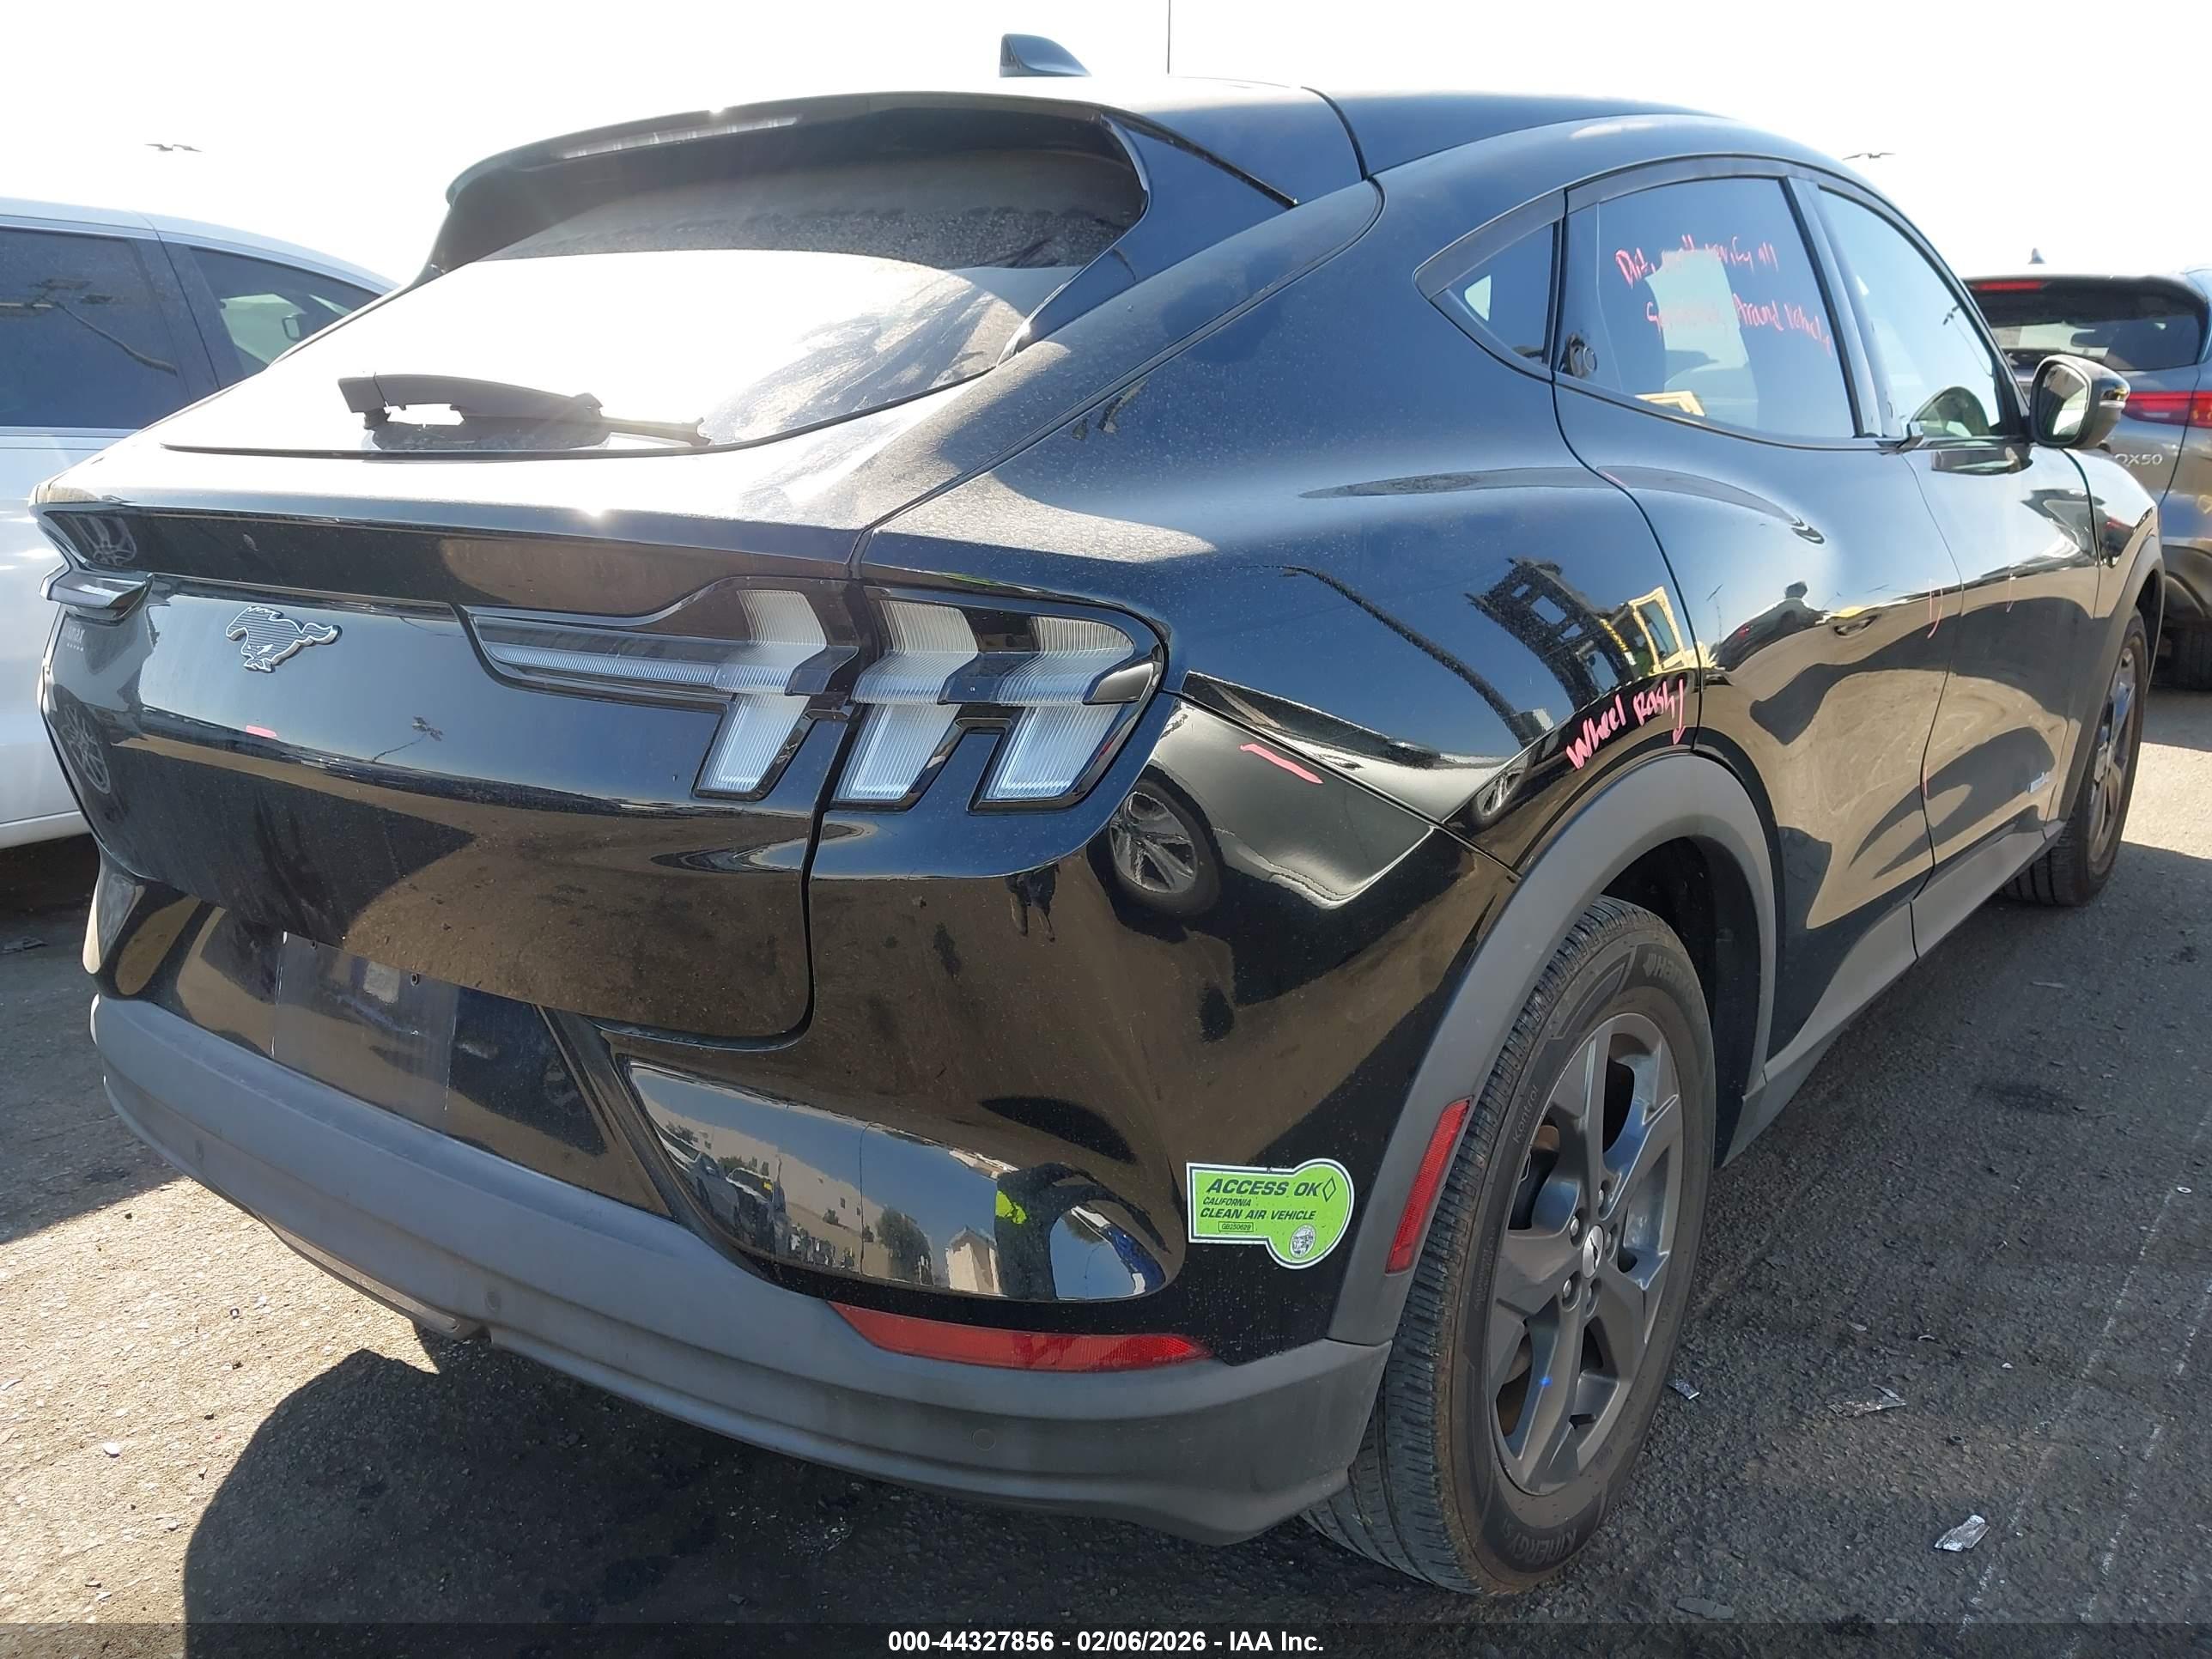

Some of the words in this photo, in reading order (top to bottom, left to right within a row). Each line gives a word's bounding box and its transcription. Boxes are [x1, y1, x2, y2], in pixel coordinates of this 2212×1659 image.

[2115, 453, 2163, 467] QX50
[1565, 693, 1627, 770] Wheel
[1632, 680, 1676, 726] Rash
[1511, 1085, 1539, 1144] Kontrol
[1206, 1178, 1290, 1196] ACCESS
[1294, 1181, 1323, 1197] OK
[1203, 1196, 1252, 1206] CALIFORNIA
[1200, 1207, 1243, 1218] CLEAN
[1245, 1209, 1267, 1220] AIR
[1271, 1210, 1316, 1220] VEHICLE
